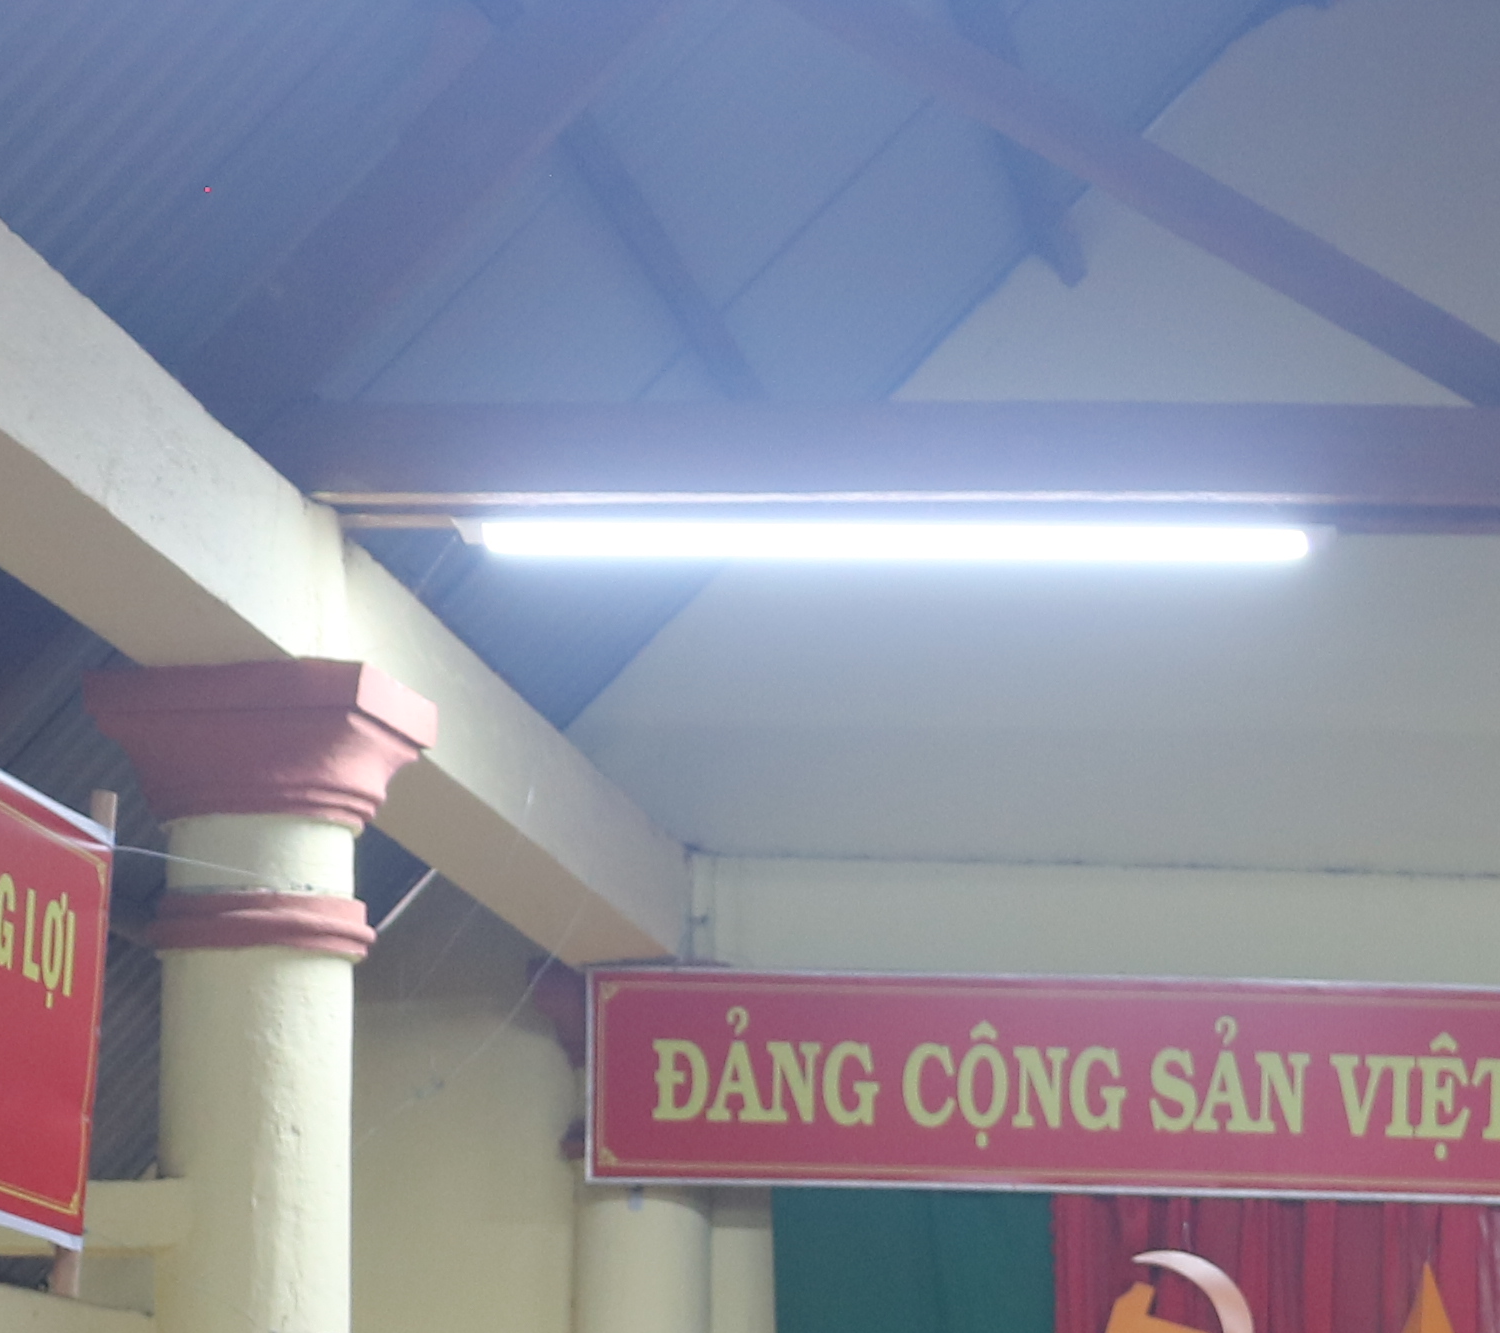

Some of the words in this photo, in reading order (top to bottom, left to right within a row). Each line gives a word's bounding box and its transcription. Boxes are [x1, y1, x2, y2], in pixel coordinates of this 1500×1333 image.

[23, 888, 76, 1009] LỢI
[651, 1006, 881, 1126] ĐẢNG
[901, 1021, 1128, 1149] CỘNG
[1149, 1016, 1311, 1136] SẢN
